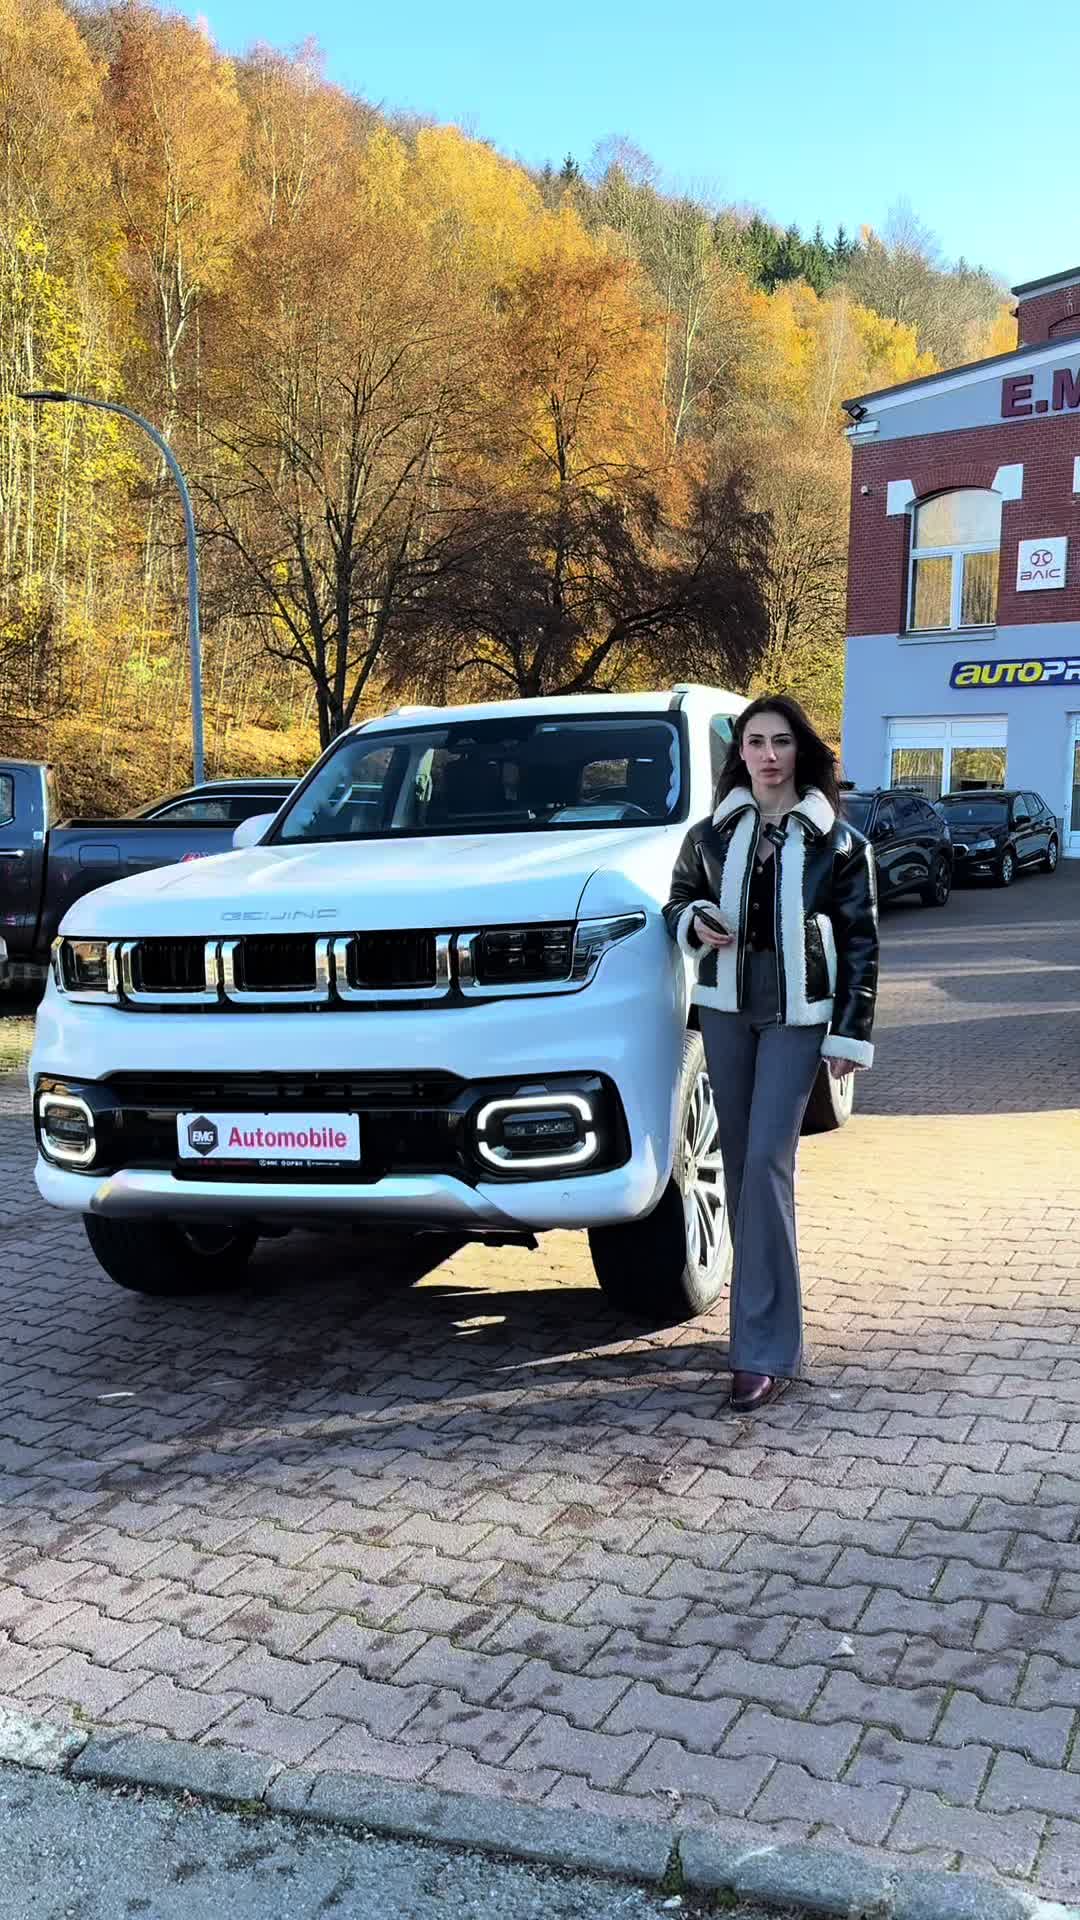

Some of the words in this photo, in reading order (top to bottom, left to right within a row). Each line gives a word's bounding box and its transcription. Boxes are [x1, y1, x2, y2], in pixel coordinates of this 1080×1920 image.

[1020, 568, 1061, 581] BAIC
[192, 1131, 214, 1142] EMG
[228, 1126, 347, 1148] Automobile
